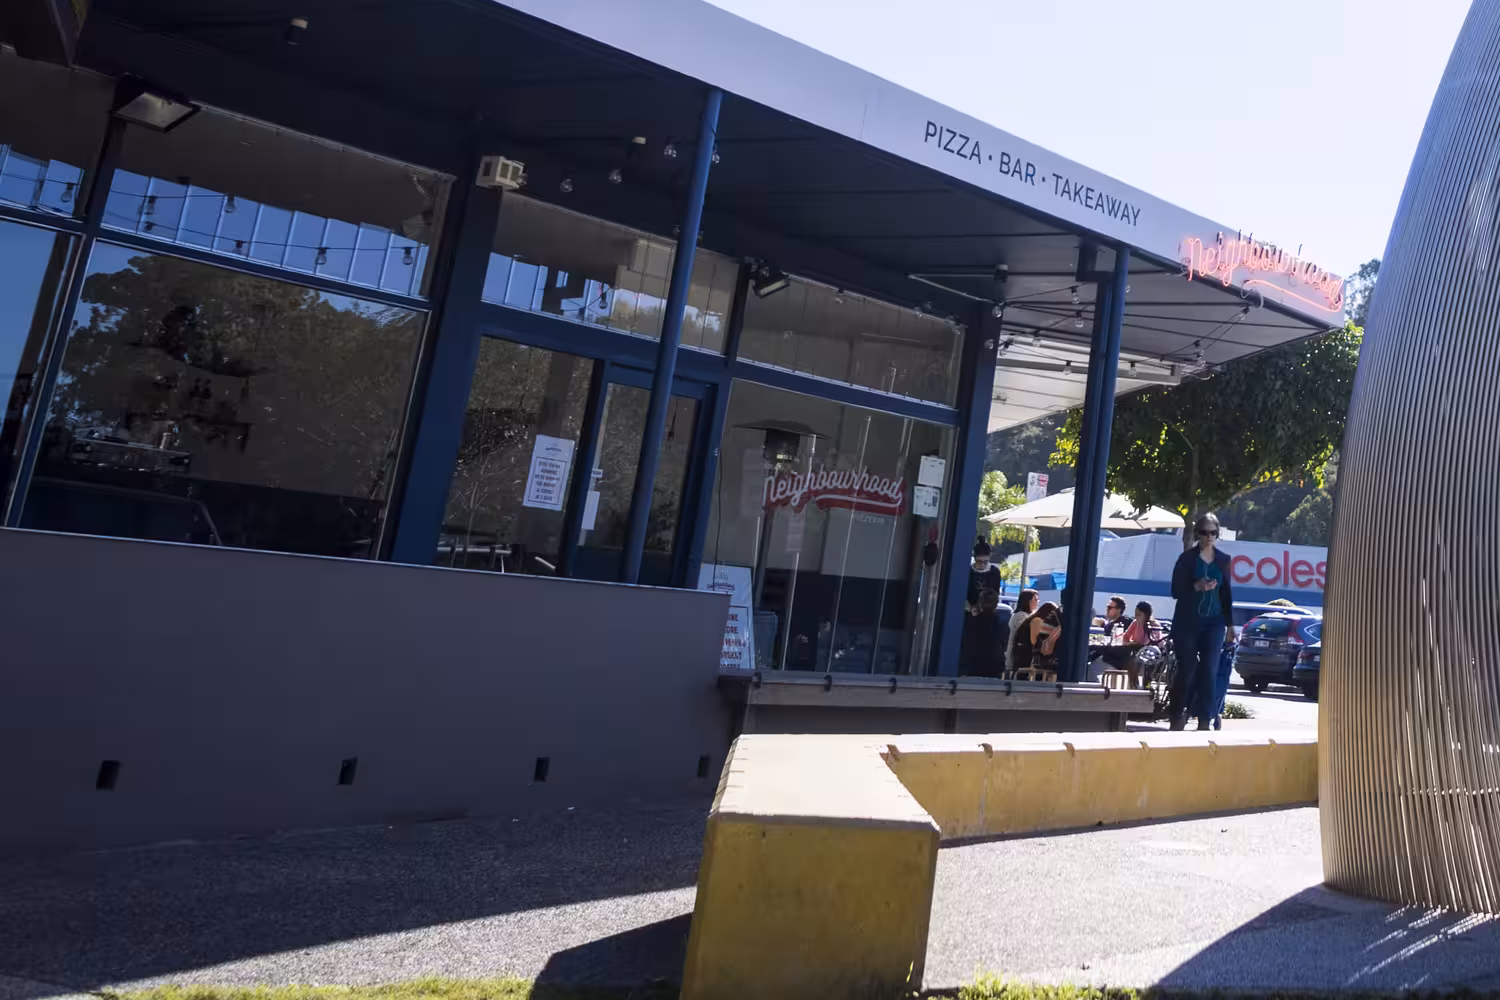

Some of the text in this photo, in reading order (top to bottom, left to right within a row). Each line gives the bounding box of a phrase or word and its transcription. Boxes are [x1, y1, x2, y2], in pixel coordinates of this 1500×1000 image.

[924, 120, 1141, 227] PIZZA BAR TAKEAWAY
[1230, 550, 1327, 589] coles
